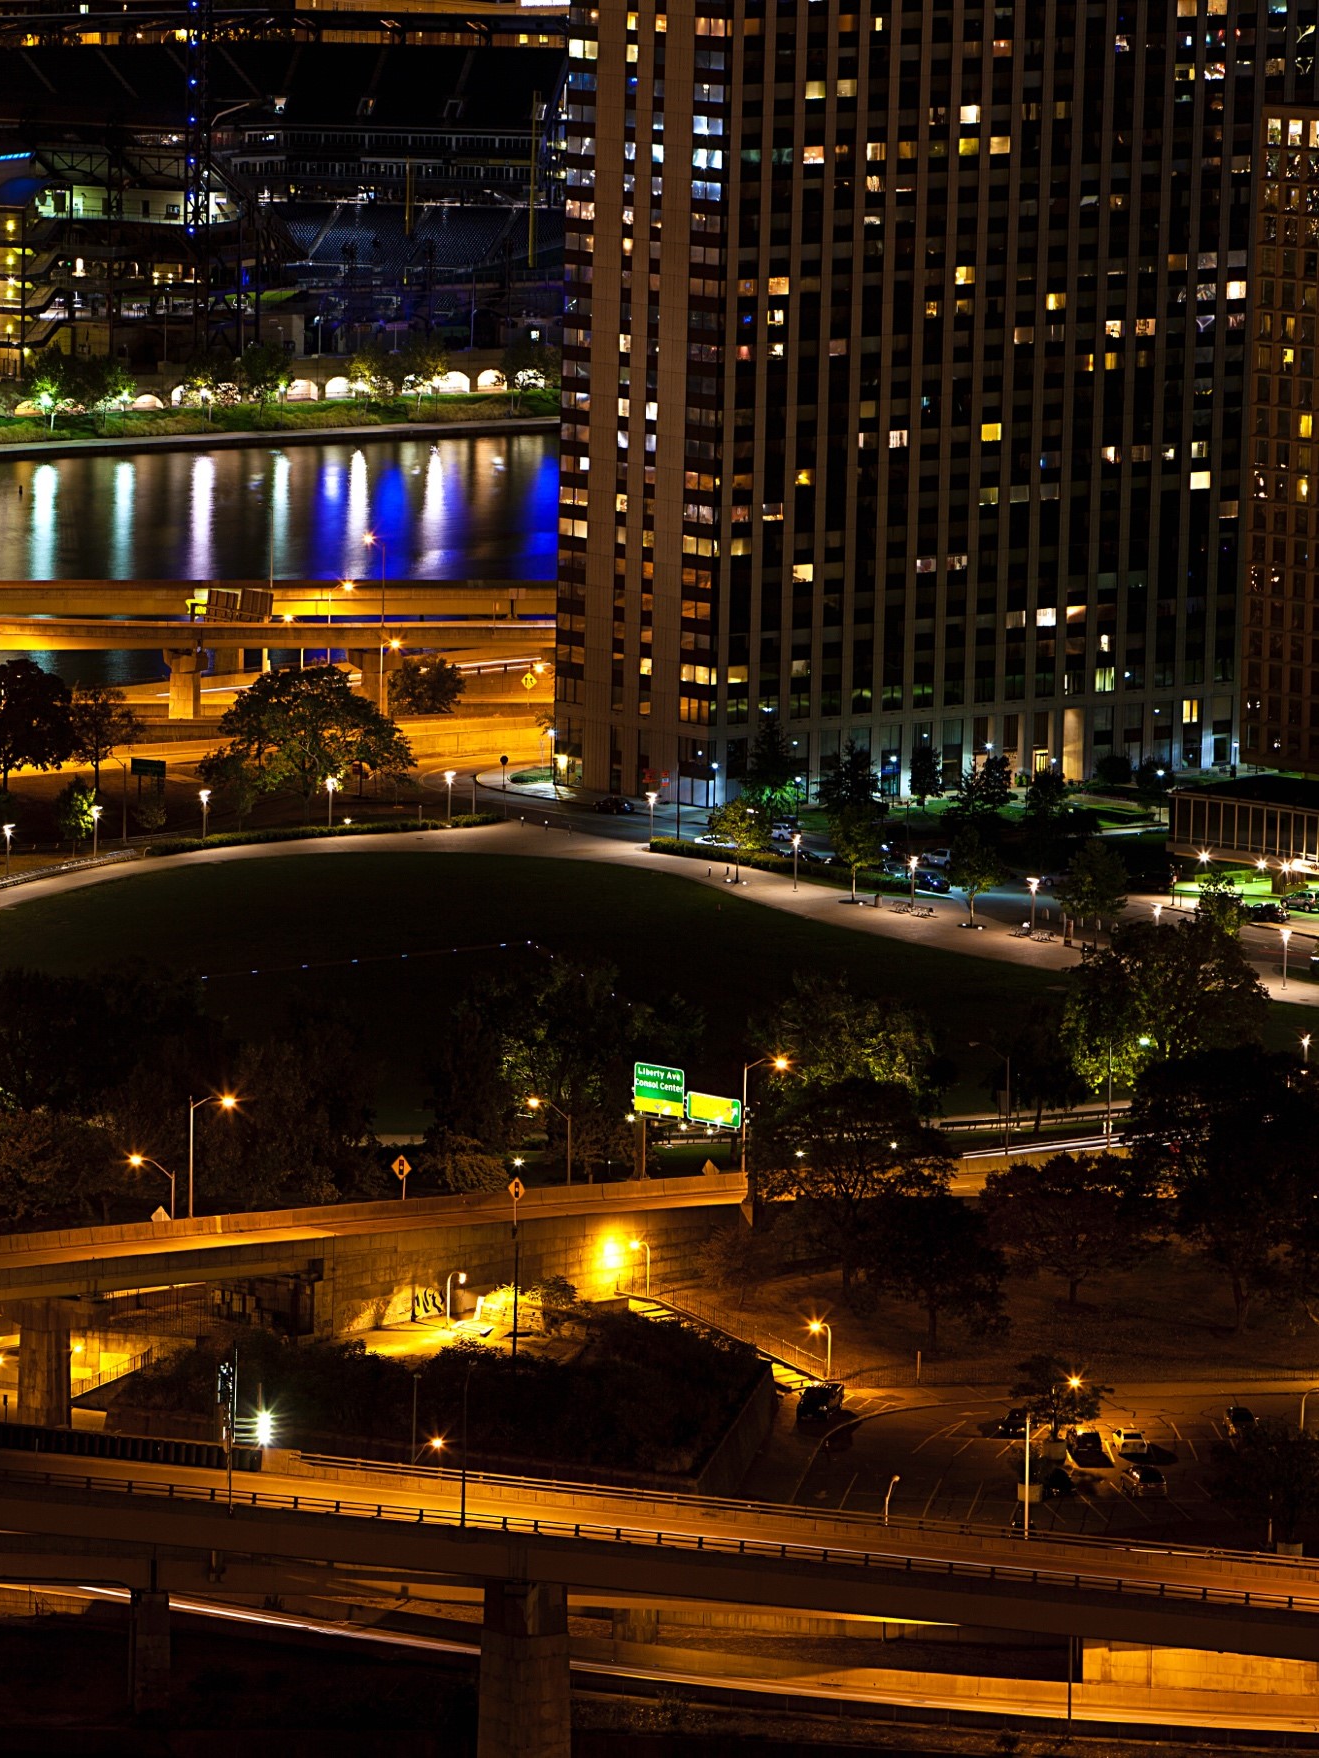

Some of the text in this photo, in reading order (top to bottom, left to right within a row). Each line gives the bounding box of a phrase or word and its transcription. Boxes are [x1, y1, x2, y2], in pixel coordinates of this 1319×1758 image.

[638, 1067, 681, 1081] Liberty Ave
[635, 1078, 683, 1092] Consol Center
